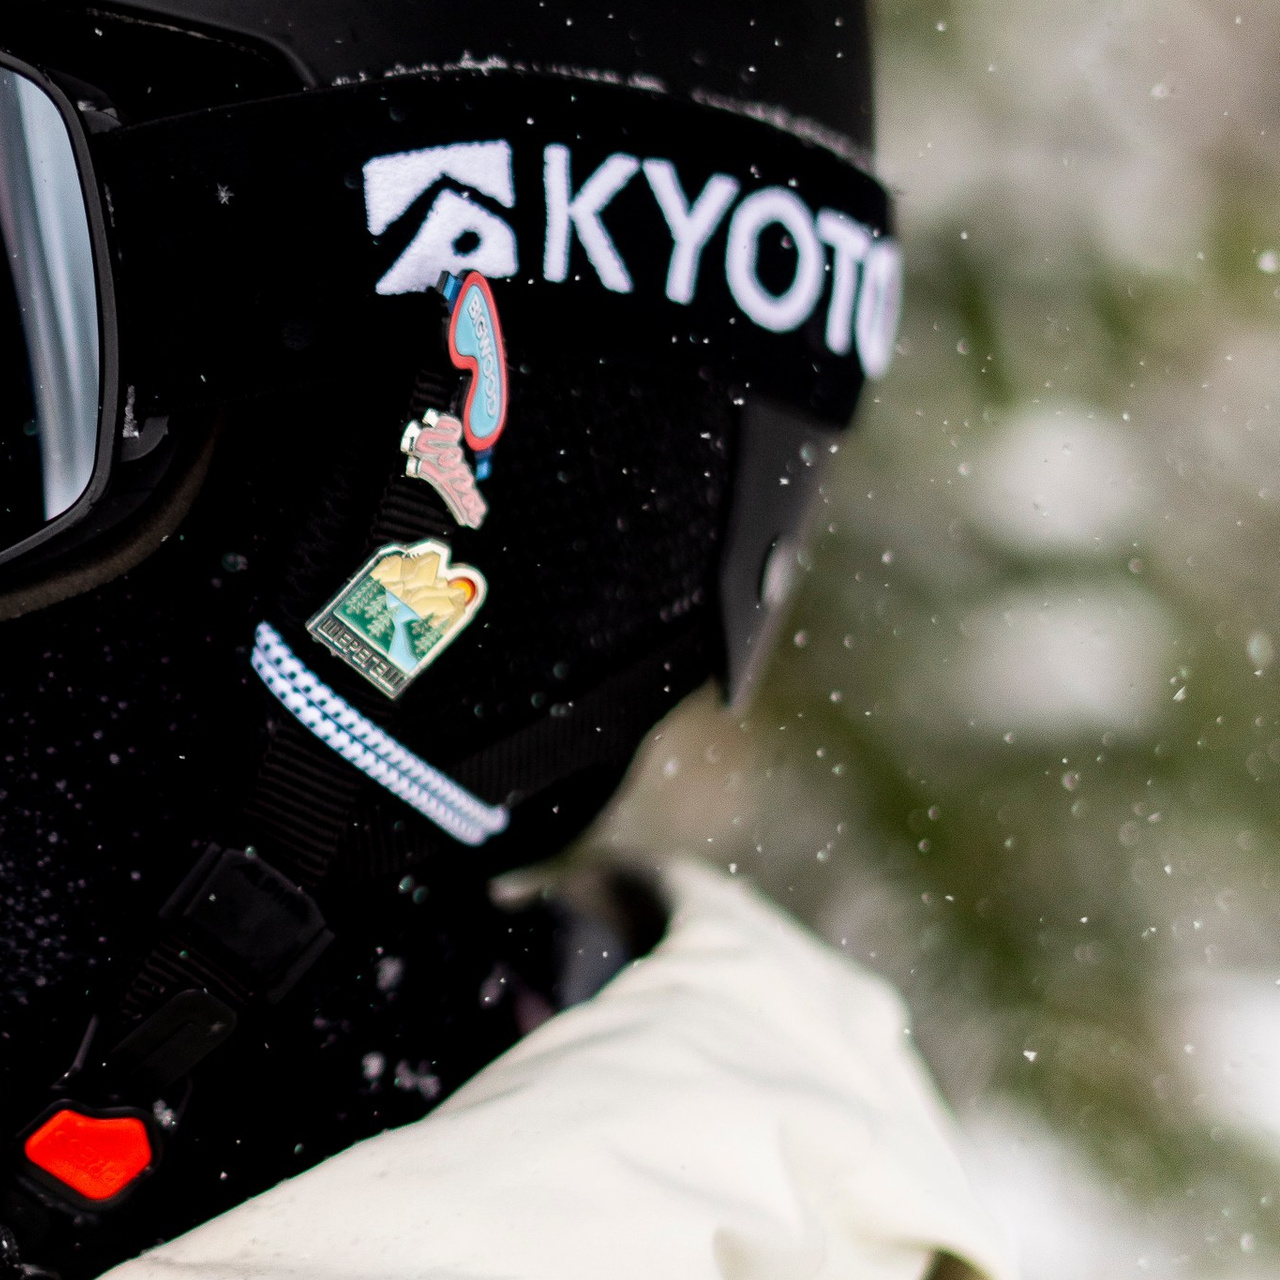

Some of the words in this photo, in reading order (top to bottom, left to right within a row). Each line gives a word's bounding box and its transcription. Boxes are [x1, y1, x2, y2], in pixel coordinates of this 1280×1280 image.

[543, 142, 904, 379] KYOTO
[468, 293, 497, 417] BIGWOOD
[317, 616, 404, 692] ШЕРЕГЕШ
